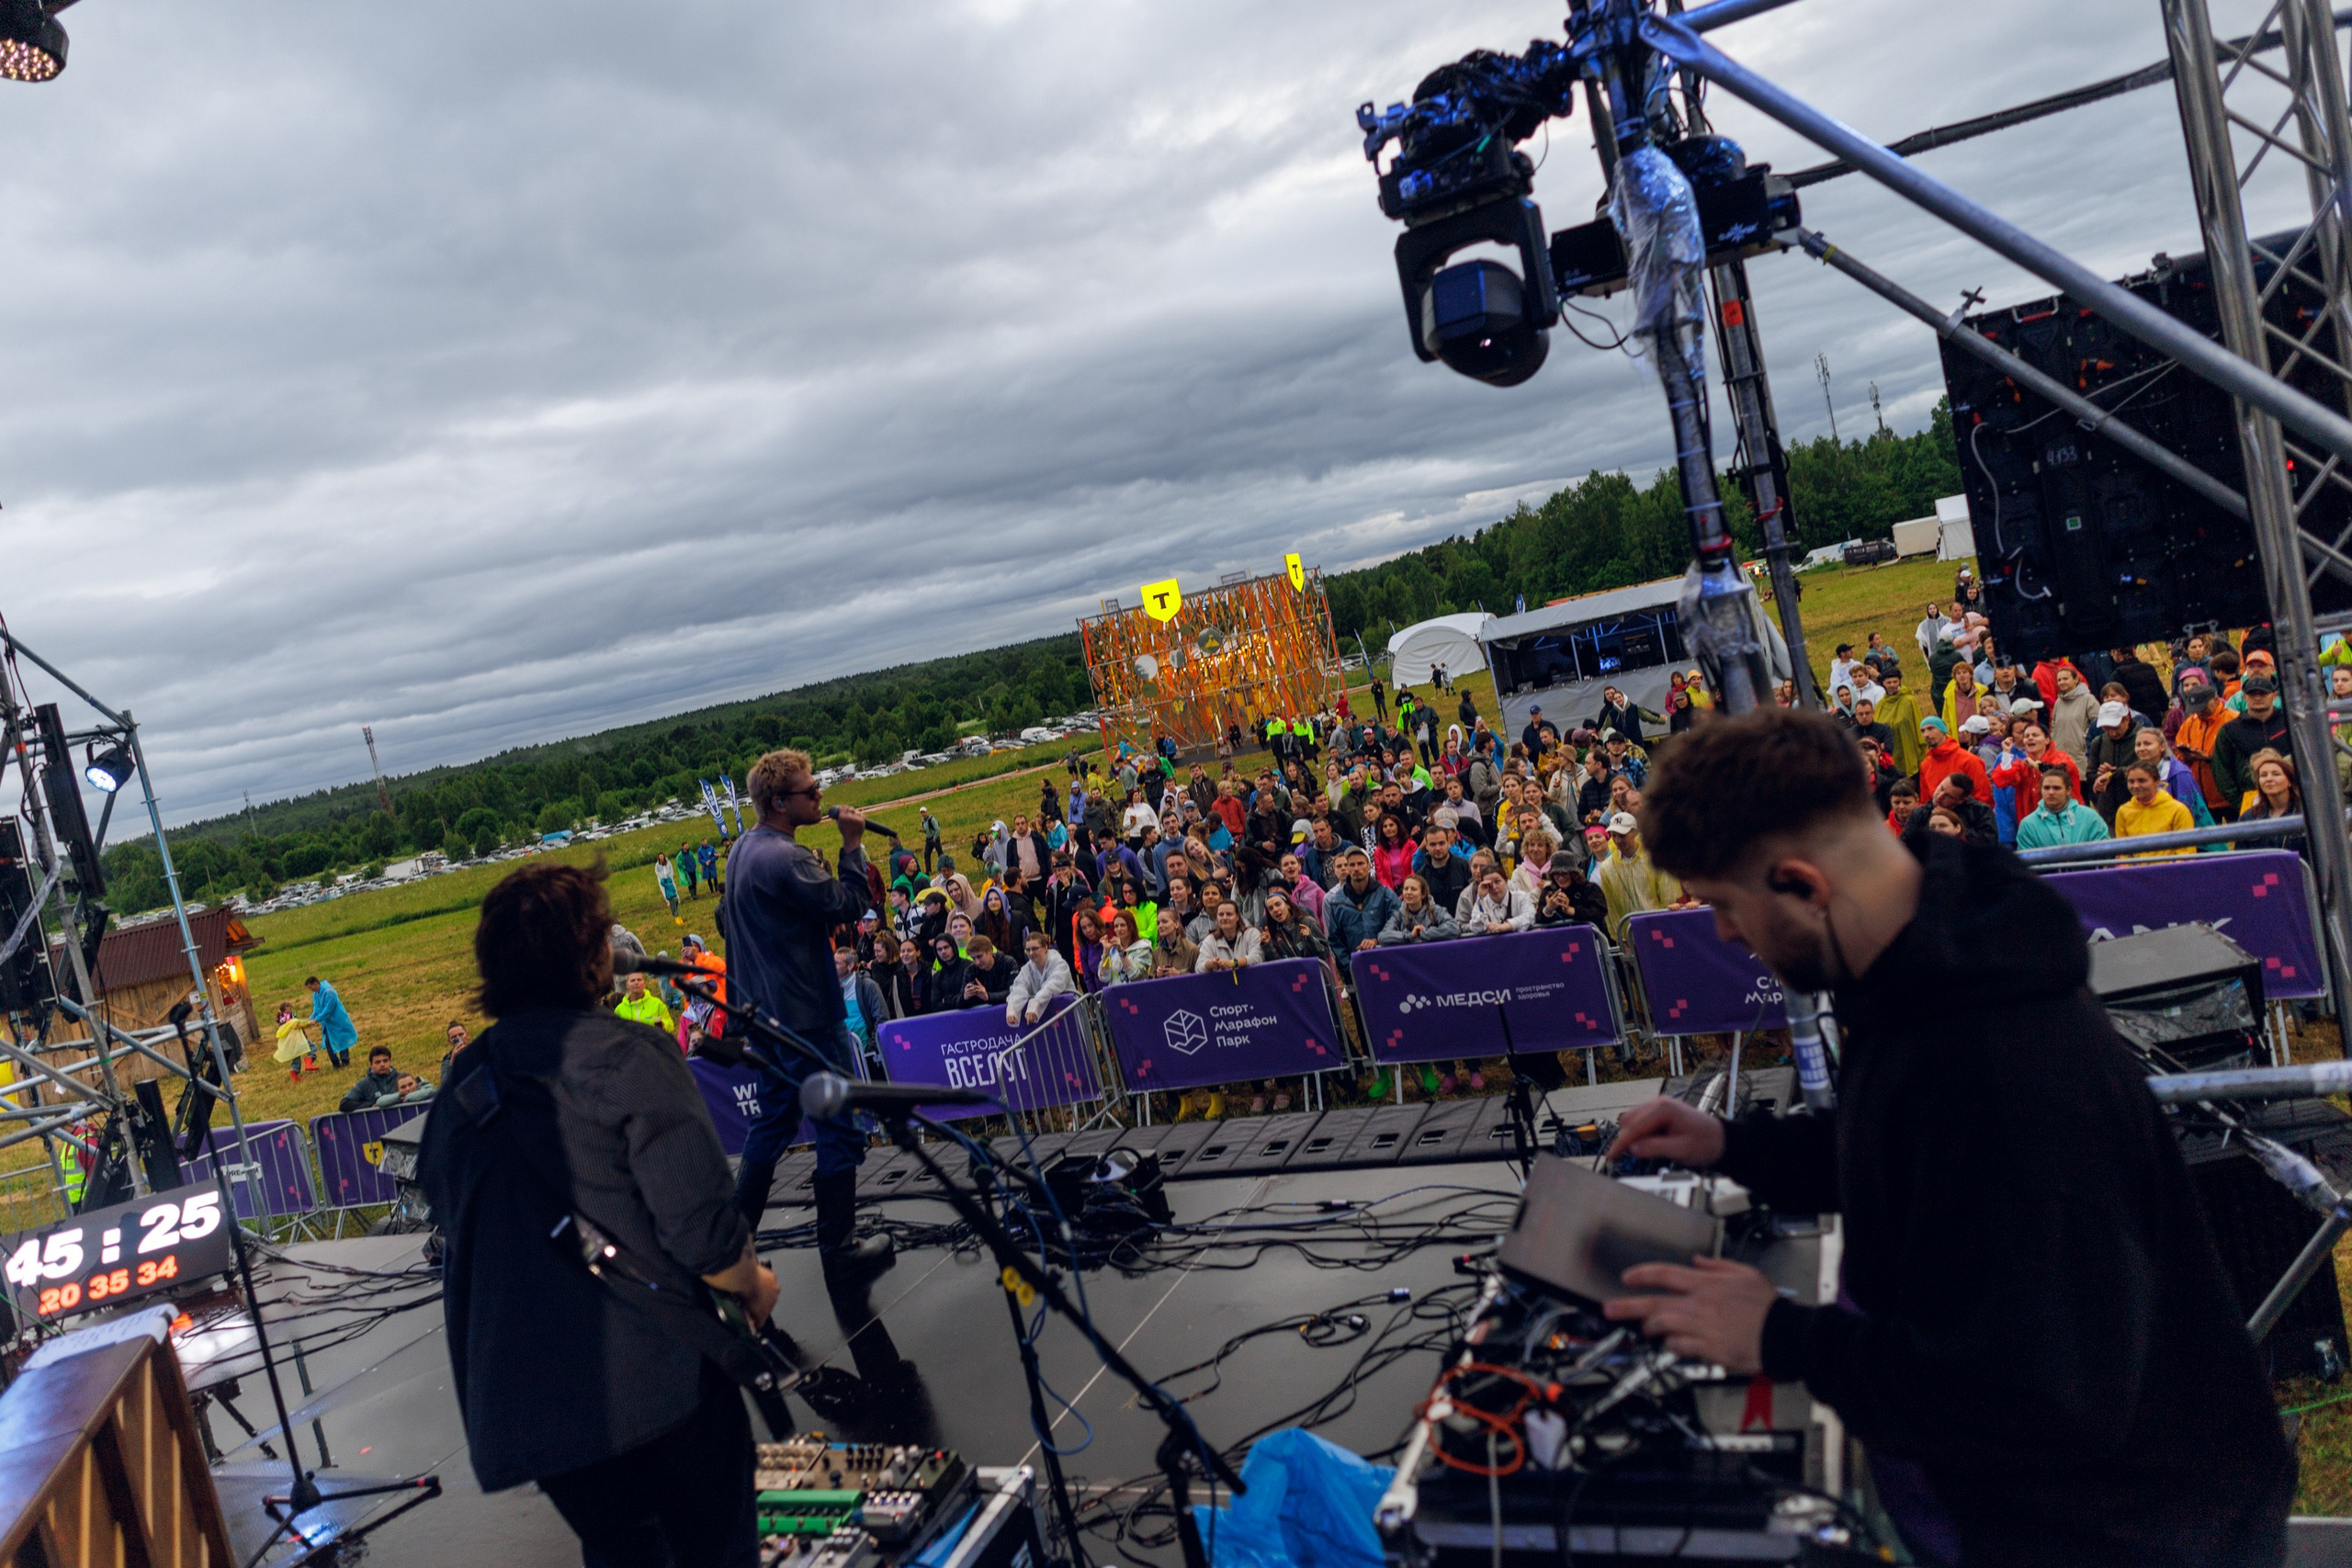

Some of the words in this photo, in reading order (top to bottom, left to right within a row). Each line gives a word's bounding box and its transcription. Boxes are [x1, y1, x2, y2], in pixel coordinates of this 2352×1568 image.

[1153, 592, 1170, 610] T
[1516, 982, 1565, 993] пространство
[1518, 991, 1550, 1000] здоровья
[1436, 989, 1511, 1007] МЕДСИ
[1215, 1015, 1277, 1032] Марафон
[941, 1032, 1022, 1055] ГАСТРОДАЧА
[1216, 1035, 1250, 1048] Парк
[39, 1282, 82, 1315] 20
[88, 1269, 130, 1300] 35
[137, 1255, 177, 1286] 34
